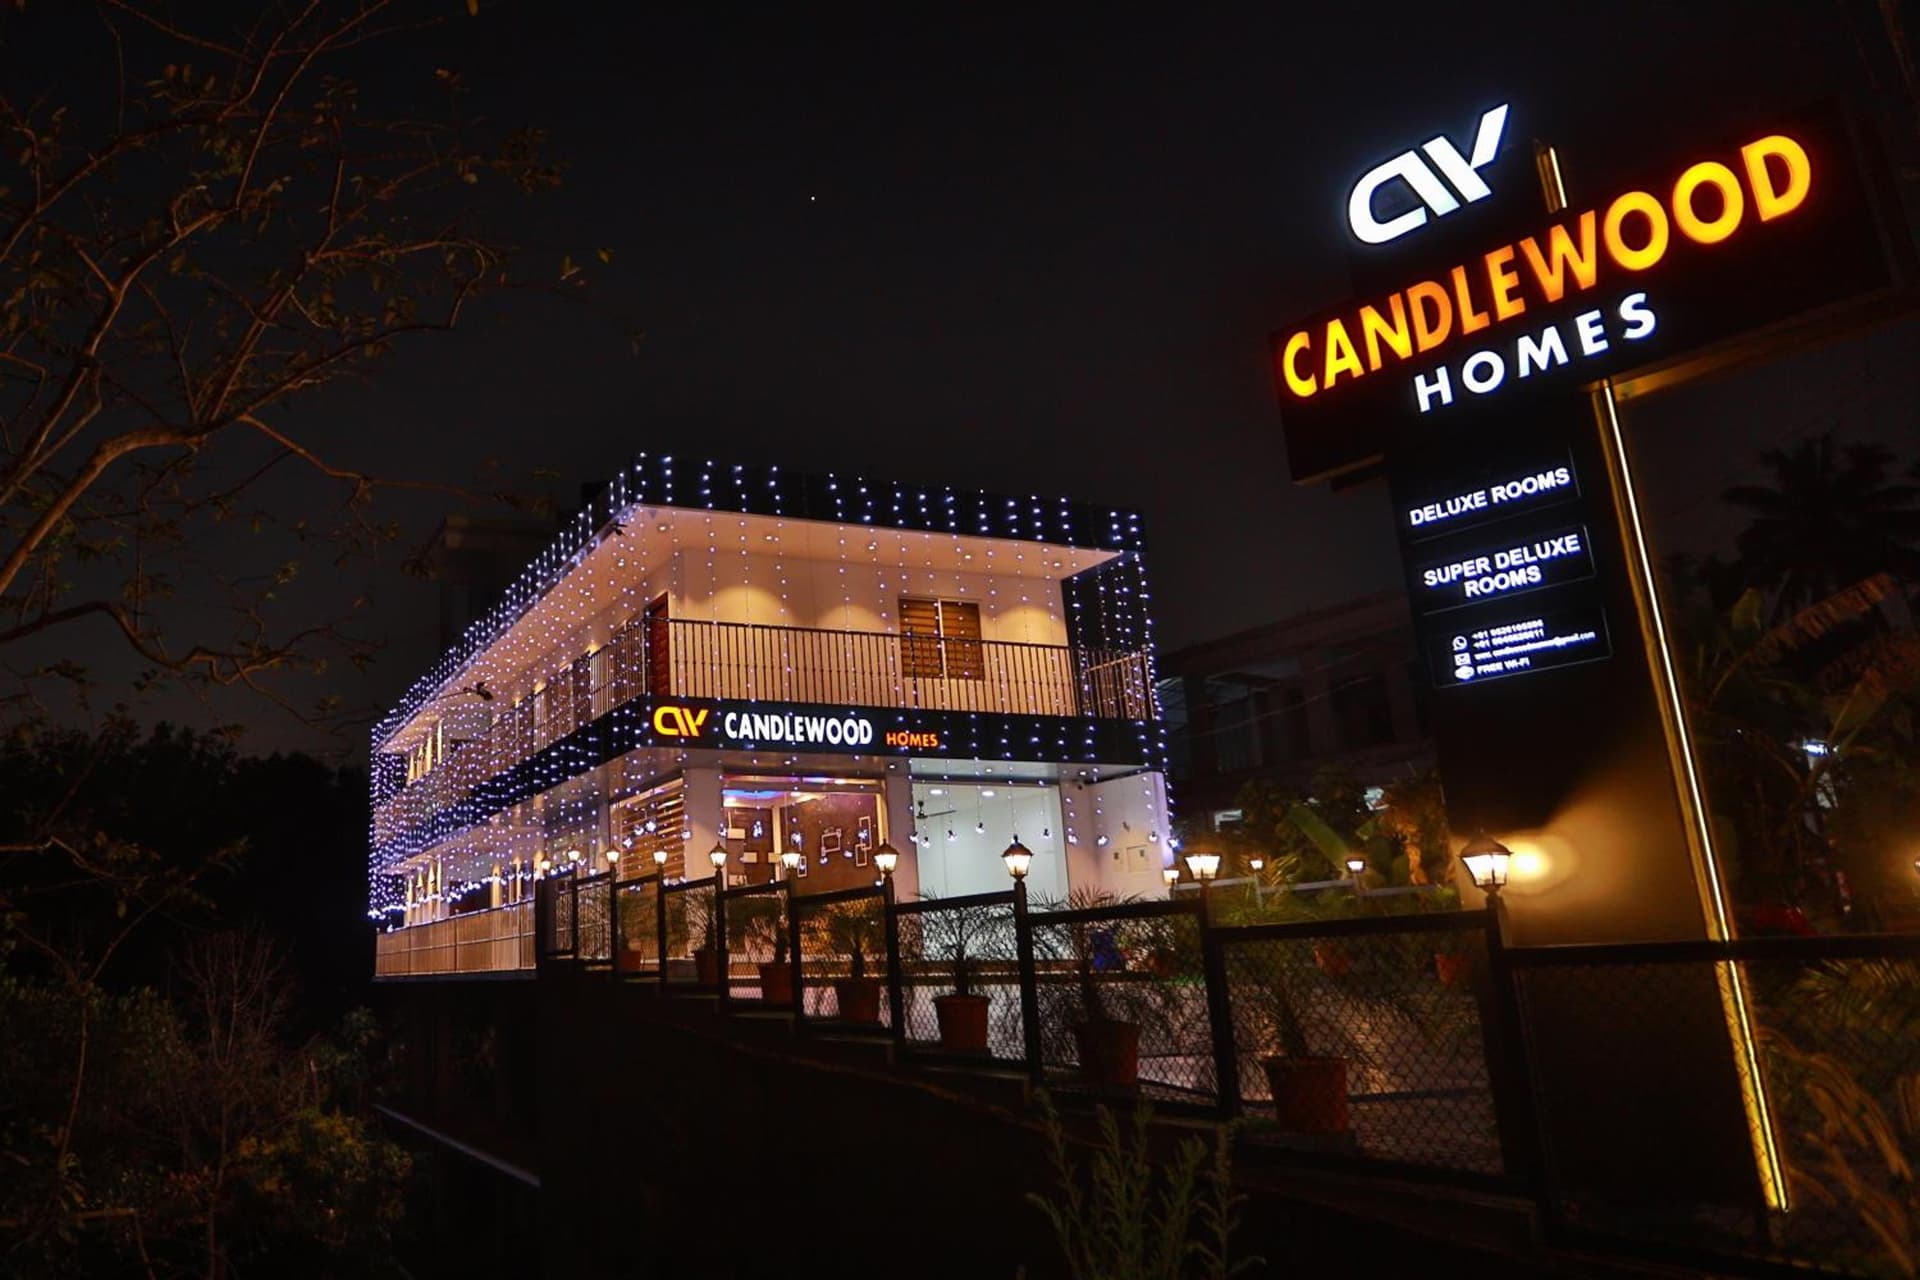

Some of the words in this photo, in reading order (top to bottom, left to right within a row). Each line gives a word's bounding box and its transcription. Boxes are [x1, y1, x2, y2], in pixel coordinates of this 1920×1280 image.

[1282, 135, 1812, 398] CANDLEWOOD
[1413, 292, 1657, 413] HOMES
[1409, 490, 1488, 525] DELUXE
[1491, 467, 1570, 503] ROOMS
[1424, 557, 1491, 586] SUPER
[1494, 533, 1581, 570] DELUXE
[1463, 565, 1542, 597] ROOMS
[724, 712, 872, 745] CANDLEWOOD
[886, 731, 938, 747] HOMES
